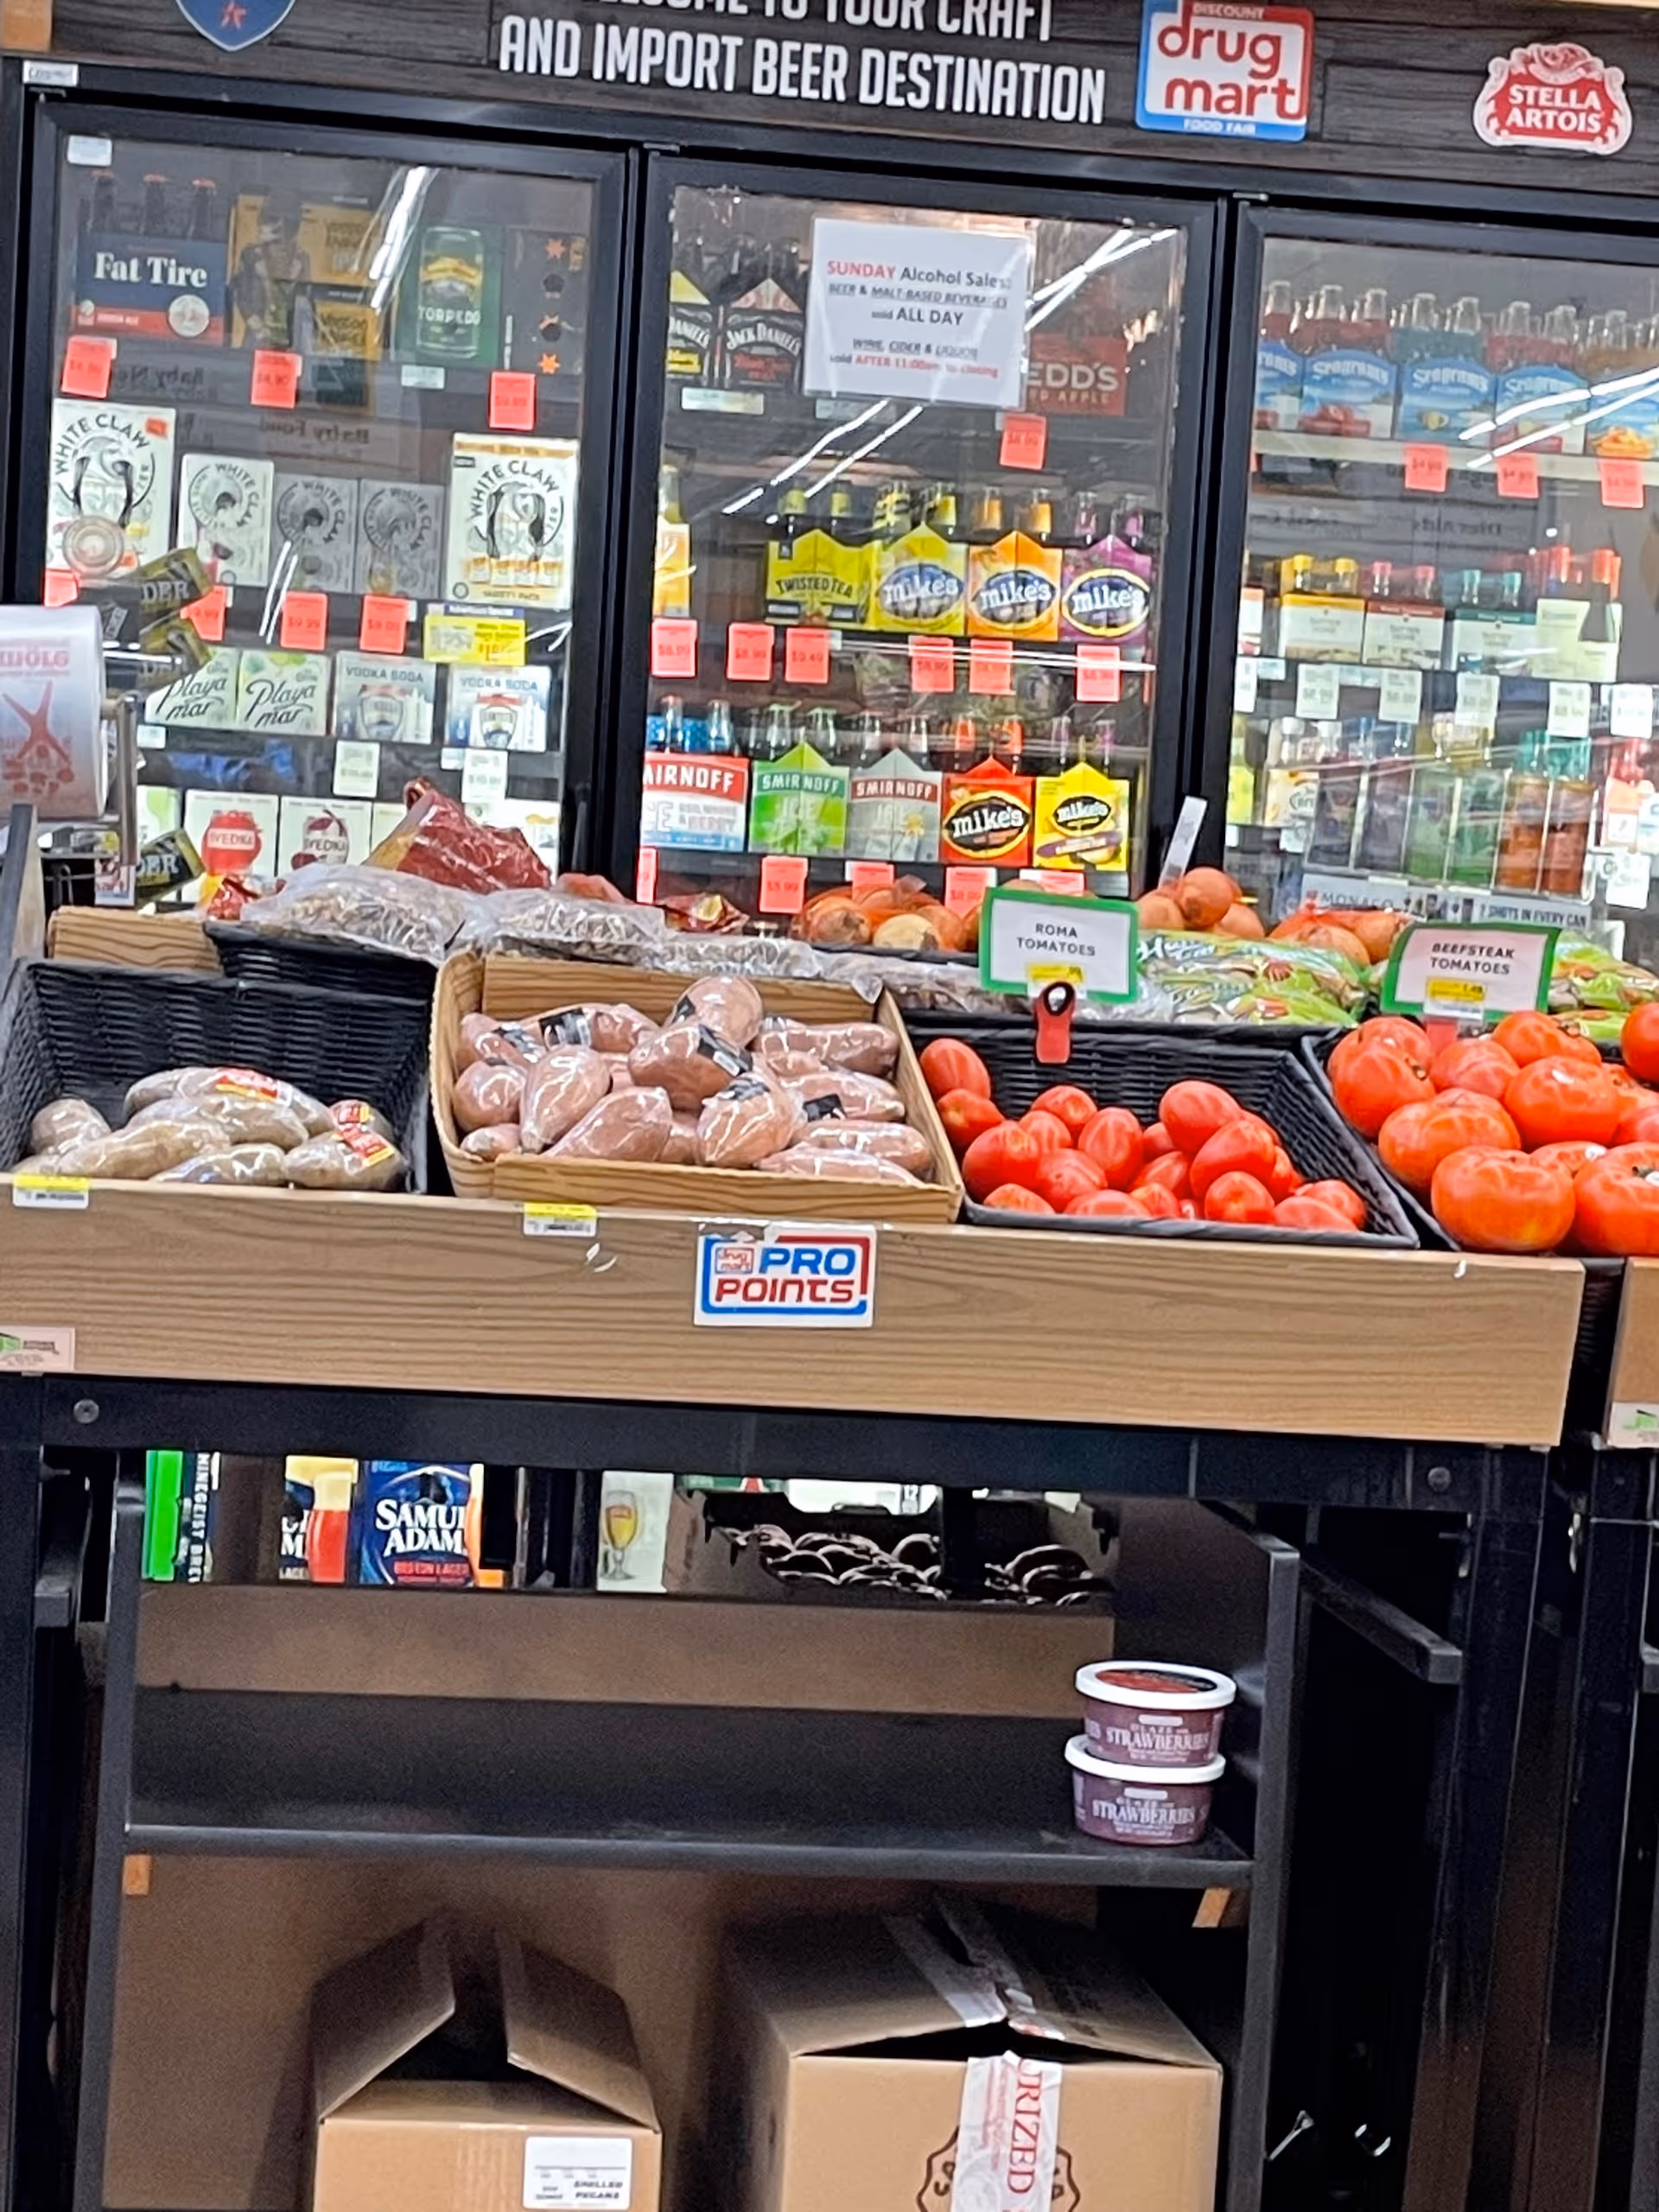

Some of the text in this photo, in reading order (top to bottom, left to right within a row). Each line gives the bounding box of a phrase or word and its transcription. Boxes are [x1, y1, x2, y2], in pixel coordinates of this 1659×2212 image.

[1192, 2, 1265, 20] DISCOUNT
[1157, 0, 1282, 80] drug
[499, 15, 1105, 124] AND IMPORT BEER DESTINATION
[1164, 77, 1303, 121] mart
[1509, 83, 1602, 111] STELLA
[1183, 118, 1256, 135] FOOD FAIR
[1505, 106, 1602, 134] ARTOIS
[93, 251, 208, 288] Fat Tire
[827, 260, 897, 279] SUNDAY
[899, 267, 962, 286] Alcohol
[828, 283, 856, 296] BEER
[859, 284, 868, 295] &
[895, 308, 925, 322] ALL
[929, 309, 964, 326] DAY
[855, 355, 891, 367] AFTER
[54, 413, 150, 475] WHITE CLAW
[470, 460, 560, 518] WHITE CLAW
[775, 575, 854, 598] TWISTED TEA
[882, 569, 960, 605] mike's
[979, 577, 1052, 611] mike's
[1072, 583, 1146, 615] mike's
[245, 678, 316, 723] Playa
[761, 773, 840, 795] SMIRNOFF
[855, 780, 932, 799] SMIRNOFF
[951, 805, 1025, 838] mike's
[1035, 922, 1078, 938] ROMA
[1016, 936, 1096, 957] TOMATOES
[1431, 942, 1516, 959] BEEFSTEAK
[1430, 957, 1511, 976] TOMATOES
[759, 1247, 856, 1275] PRO
[715, 1277, 855, 1304] POINTS
[375, 1498, 466, 1531] SAMU
[383, 1528, 468, 1558] ADAM
[1106, 1726, 1211, 1752] STRAWBERRIES
[1092, 1798, 1196, 1825] STRAWBERRIES
